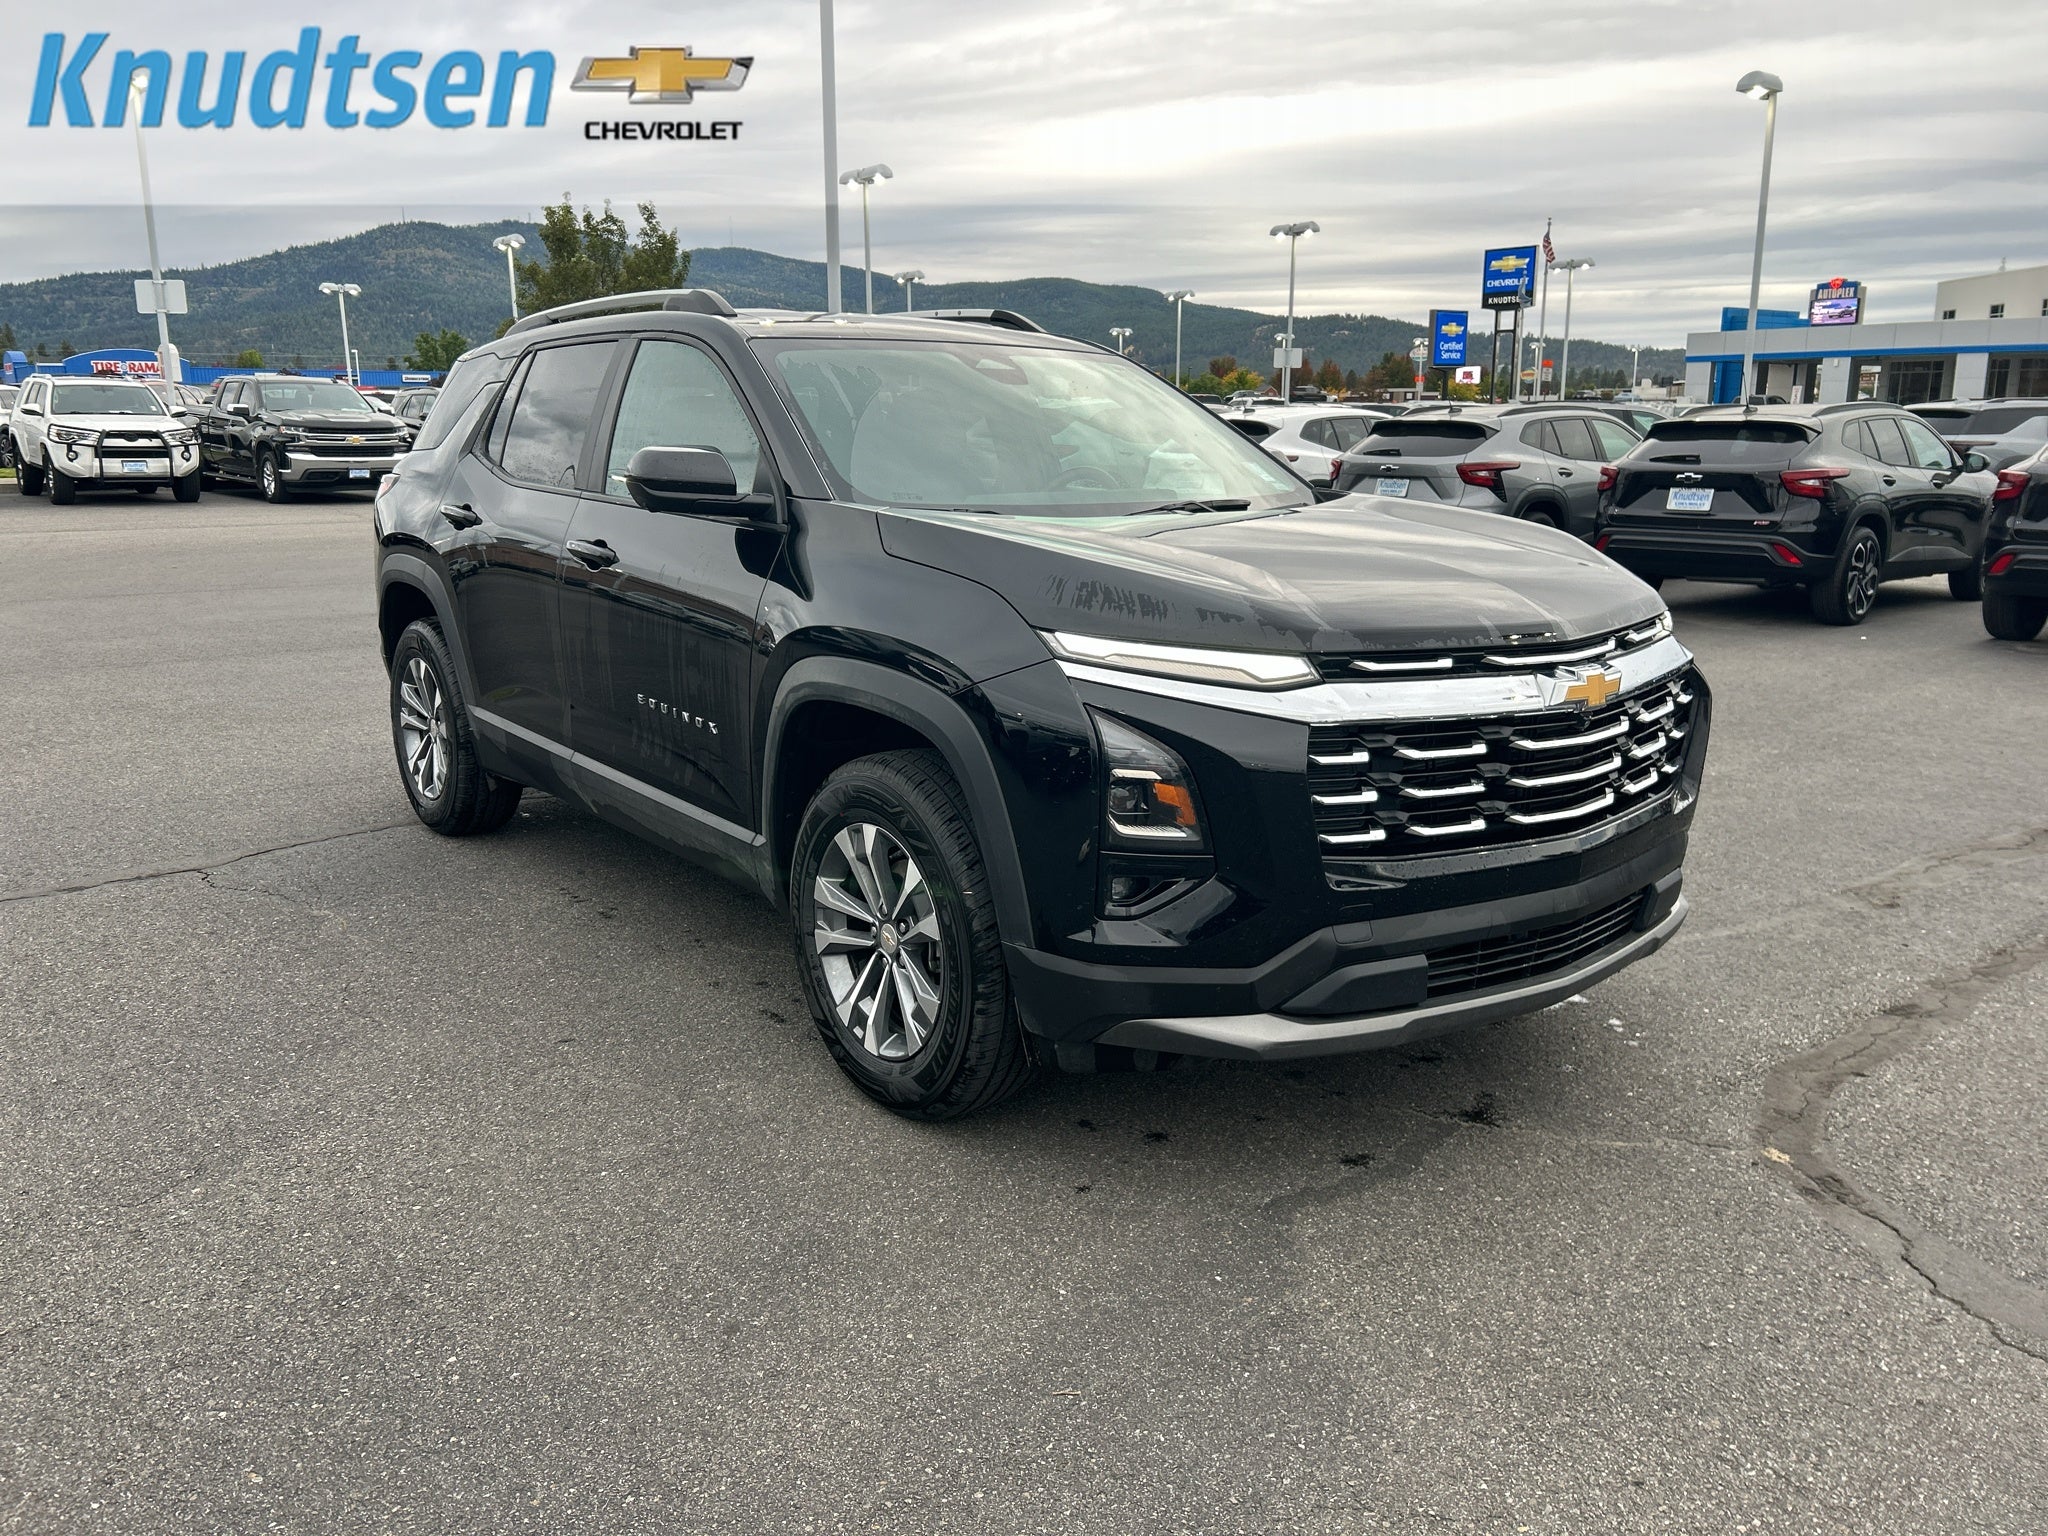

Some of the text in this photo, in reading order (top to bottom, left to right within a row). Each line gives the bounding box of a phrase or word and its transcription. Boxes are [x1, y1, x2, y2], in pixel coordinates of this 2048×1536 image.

[1817, 287, 1855, 300] AUTOPLEX
[1488, 296, 1520, 304] KNUDTSE
[1440, 341, 1463, 350] Certified
[1441, 350, 1461, 359] Service
[92, 361, 119, 374] TIRE
[1672, 491, 1710, 501] Knudtsen
[637, 693, 719, 735] EQUINOX
